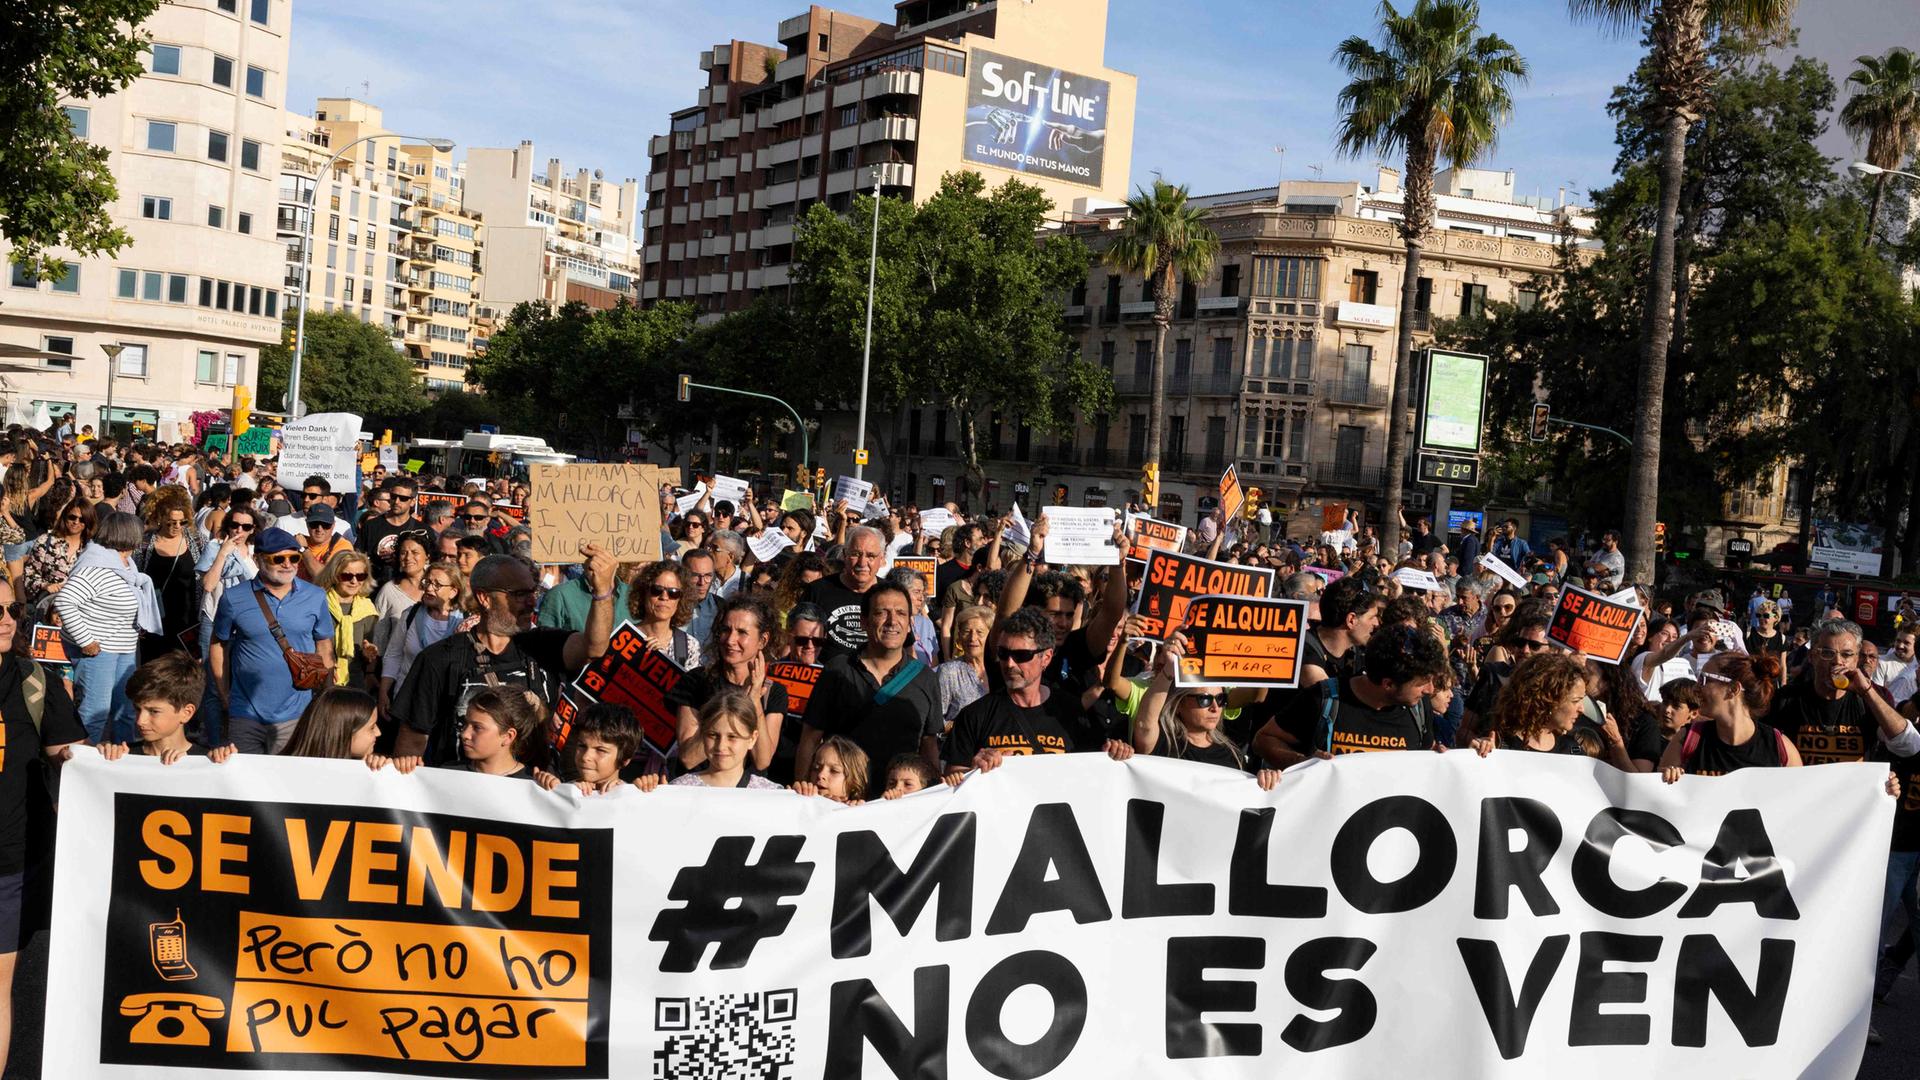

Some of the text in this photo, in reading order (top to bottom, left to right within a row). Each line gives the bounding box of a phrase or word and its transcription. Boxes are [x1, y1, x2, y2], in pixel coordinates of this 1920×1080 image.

[976, 144, 1090, 177] EL MUNDO EN TUS MANOS
[199, 315, 218, 325] HOTEL
[541, 465, 629, 484] ESTIMAM
[419, 494, 429, 505] SE
[536, 482, 645, 510] MALLORCA
[536, 508, 642, 534] I VOLEM
[1145, 522, 1182, 542] VENDE
[1731, 541, 1750, 552] GOIKO
[907, 561, 935, 573] VENDE
[1150, 555, 1265, 598] SE ALQUILA
[1186, 602, 1209, 628] SE
[1212, 603, 1298, 633] ALQUILA
[1562, 591, 1637, 629] SE ALQUILA
[36, 628, 48, 640] SE
[1234, 642, 1252, 654] NO
[611, 630, 643, 661] SE
[639, 648, 681, 693] VEN
[1222, 661, 1272, 675] PAGAR
[773, 663, 822, 683] VENDE
[559, 700, 573, 721] SE
[989, 734, 1065, 748] MALLRCA
[1333, 731, 1407, 748] MALLORCA
[1801, 735, 1859, 751] NO ES
[138, 810, 580, 919] SE VENDE
[648, 795, 1800, 973] #MALLORCA
[242, 924, 577, 991] Però no ho
[823, 931, 1796, 1080] NO ES VEN
[246, 998, 556, 1062] puc pagar
